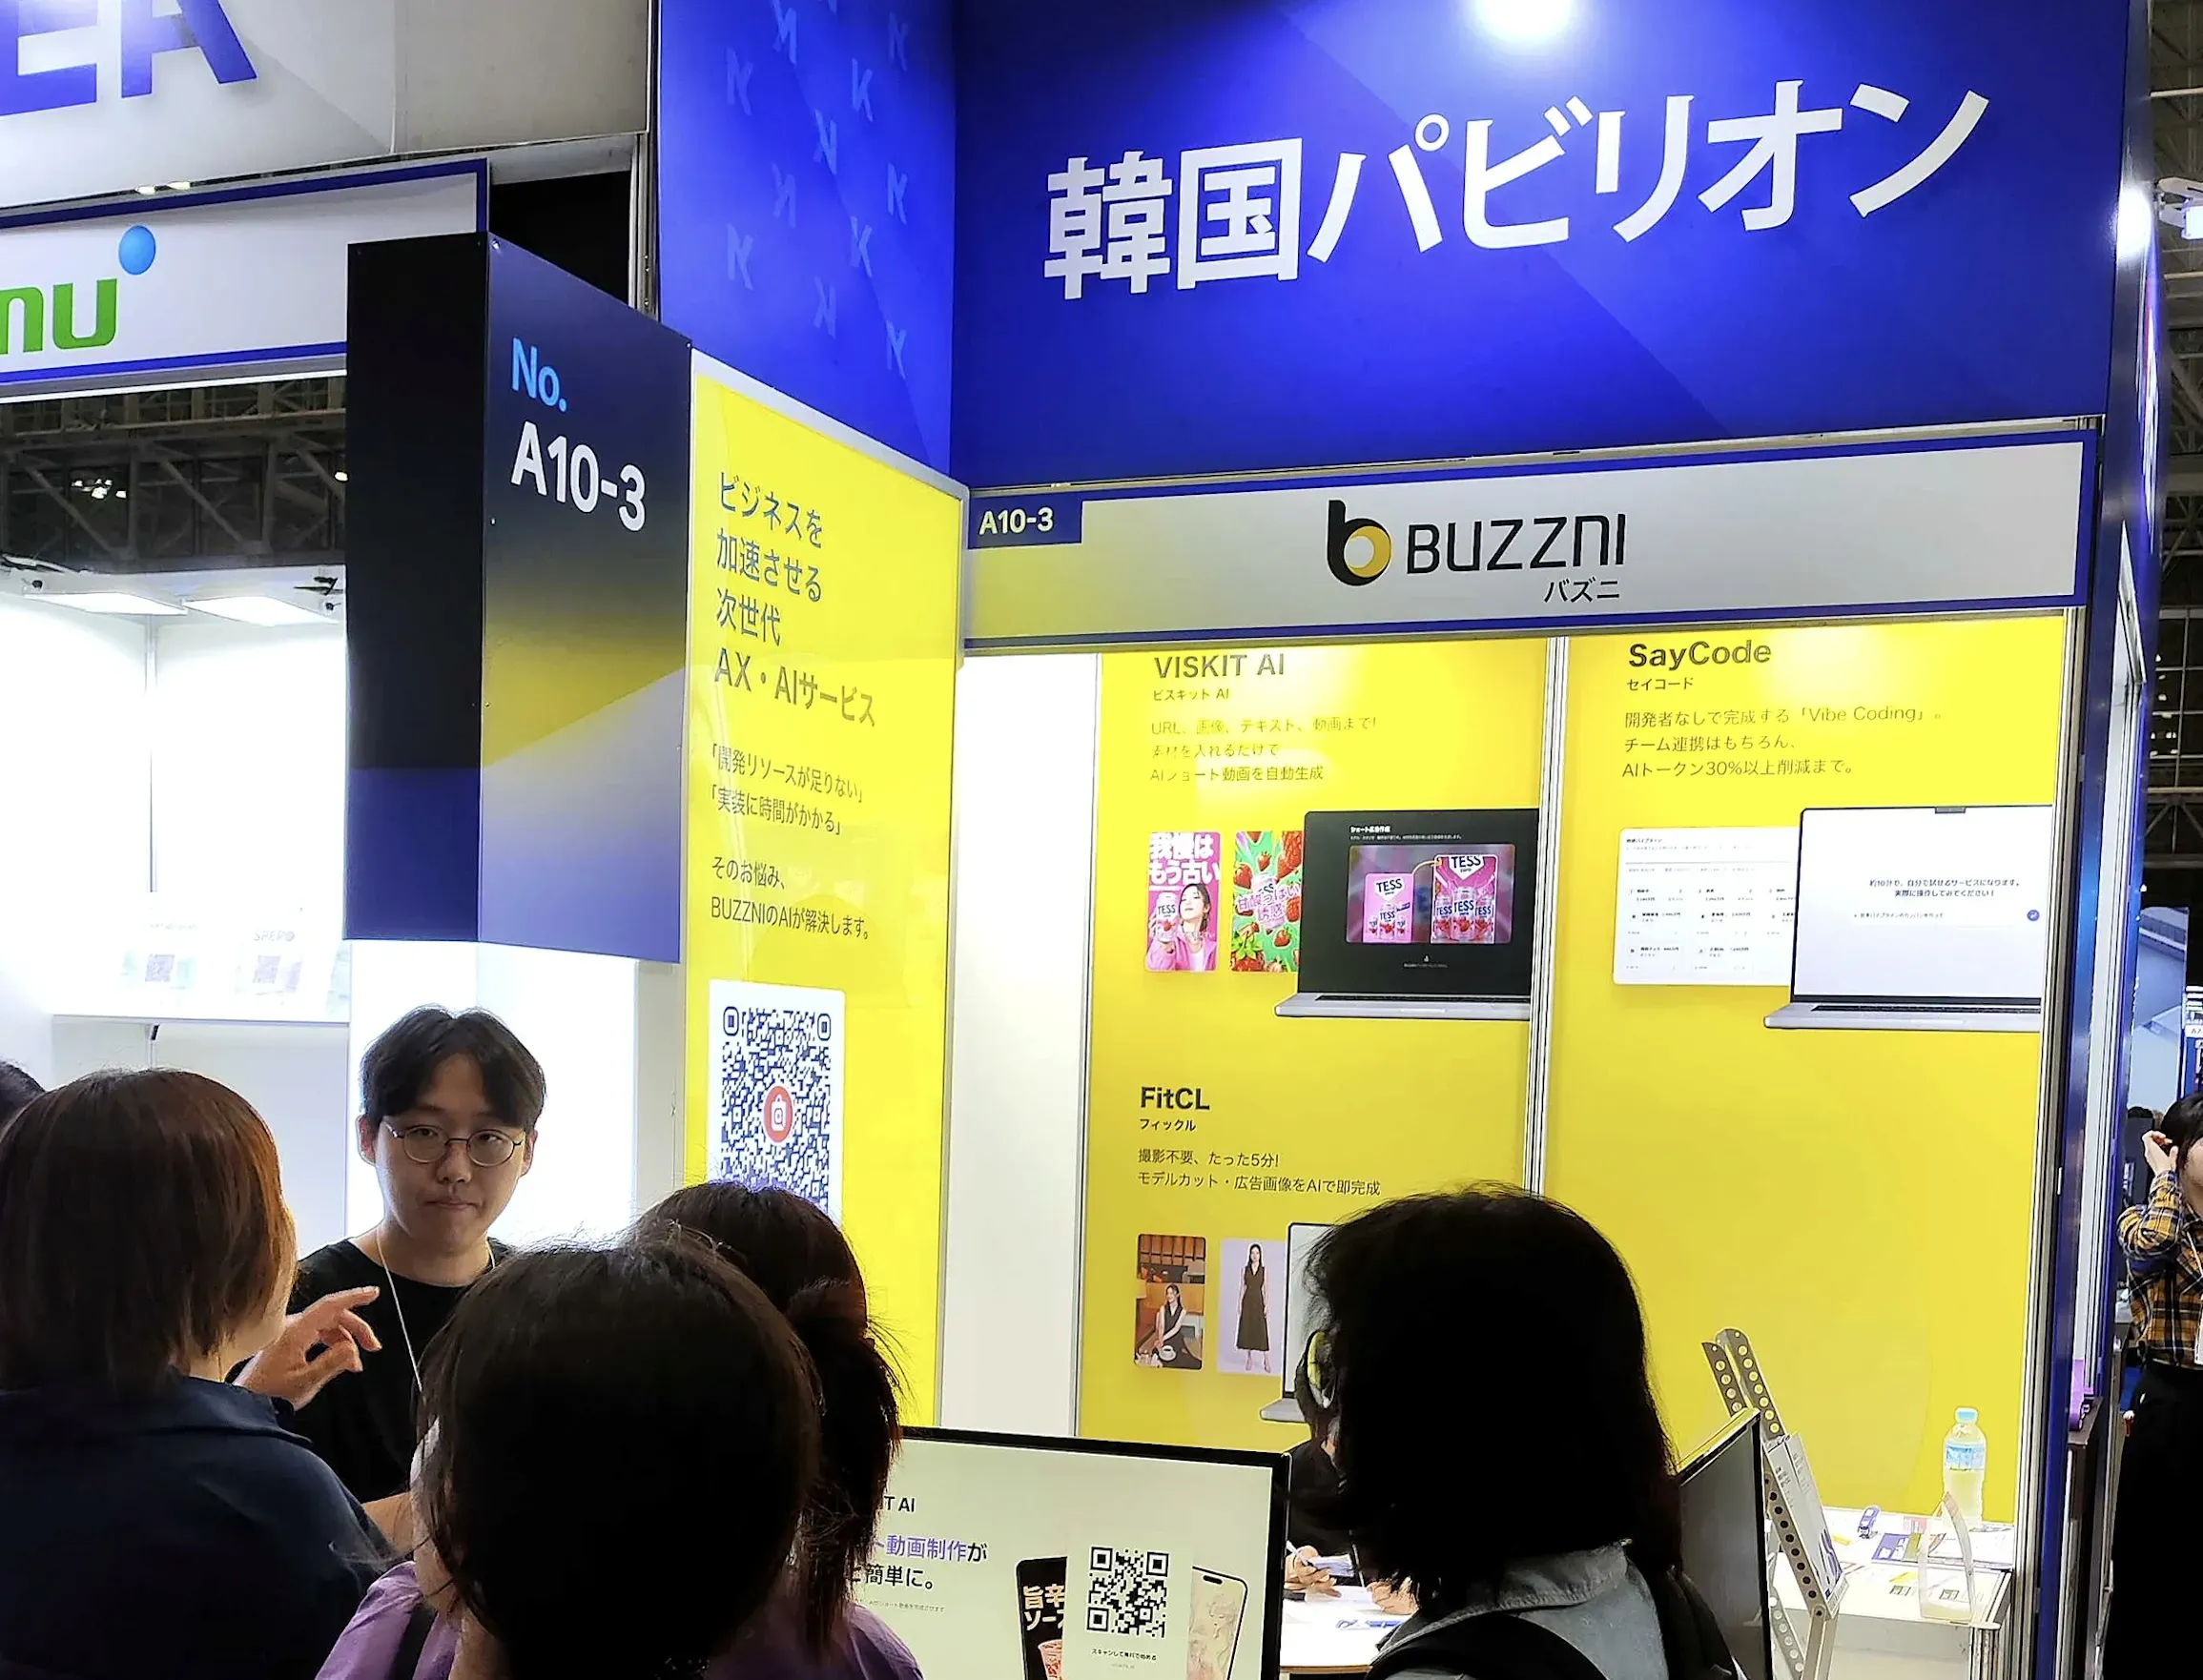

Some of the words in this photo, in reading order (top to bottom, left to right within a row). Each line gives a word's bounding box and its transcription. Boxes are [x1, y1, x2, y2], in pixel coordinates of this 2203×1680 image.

[1044, 80, 1989, 299] 韓国パビリオン
[512, 337, 566, 412] No.
[510, 420, 646, 532] A10-3
[720, 471, 823, 549] ビジネスを
[978, 506, 1054, 536] A10-3
[1407, 513, 1627, 574] BUZZNI
[716, 527, 822, 603] 加速させる
[1544, 576, 1620, 604] バズニ
[716, 587, 781, 647] 次世代
[1154, 653, 1248, 679] VISKIT
[1257, 653, 1285, 676] AI
[1628, 640, 1772, 671] SayCode
[714, 647, 875, 727] AX・AIサービス
[1216, 688, 1229, 700] AI
[1626, 677, 1695, 691] セイコード
[1624, 735, 1796, 752] チーム連携はもちろん、
[711, 743, 863, 803] 「開発リソースが足りない」
[1621, 758, 1853, 778] AIトークン30%以上削減まで。
[711, 784, 841, 836] 「実装に時間がかかる」
[711, 856, 786, 890] そのお悩み、
[1376, 878, 1403, 893] TESS
[710, 895, 869, 940] BUZZNIのAIが解決します。
[1140, 1086, 1210, 1111] FitCL
[1140, 1118, 1197, 1132] フィックル
[1138, 1148, 1280, 1168] 撮影不要、たった5分!
[1138, 1171, 1381, 1196] モデルカット・広告画像をAIで即完成
[897, 1497, 916, 1513] AI
[875, 1534, 988, 1563] 動画制作が
